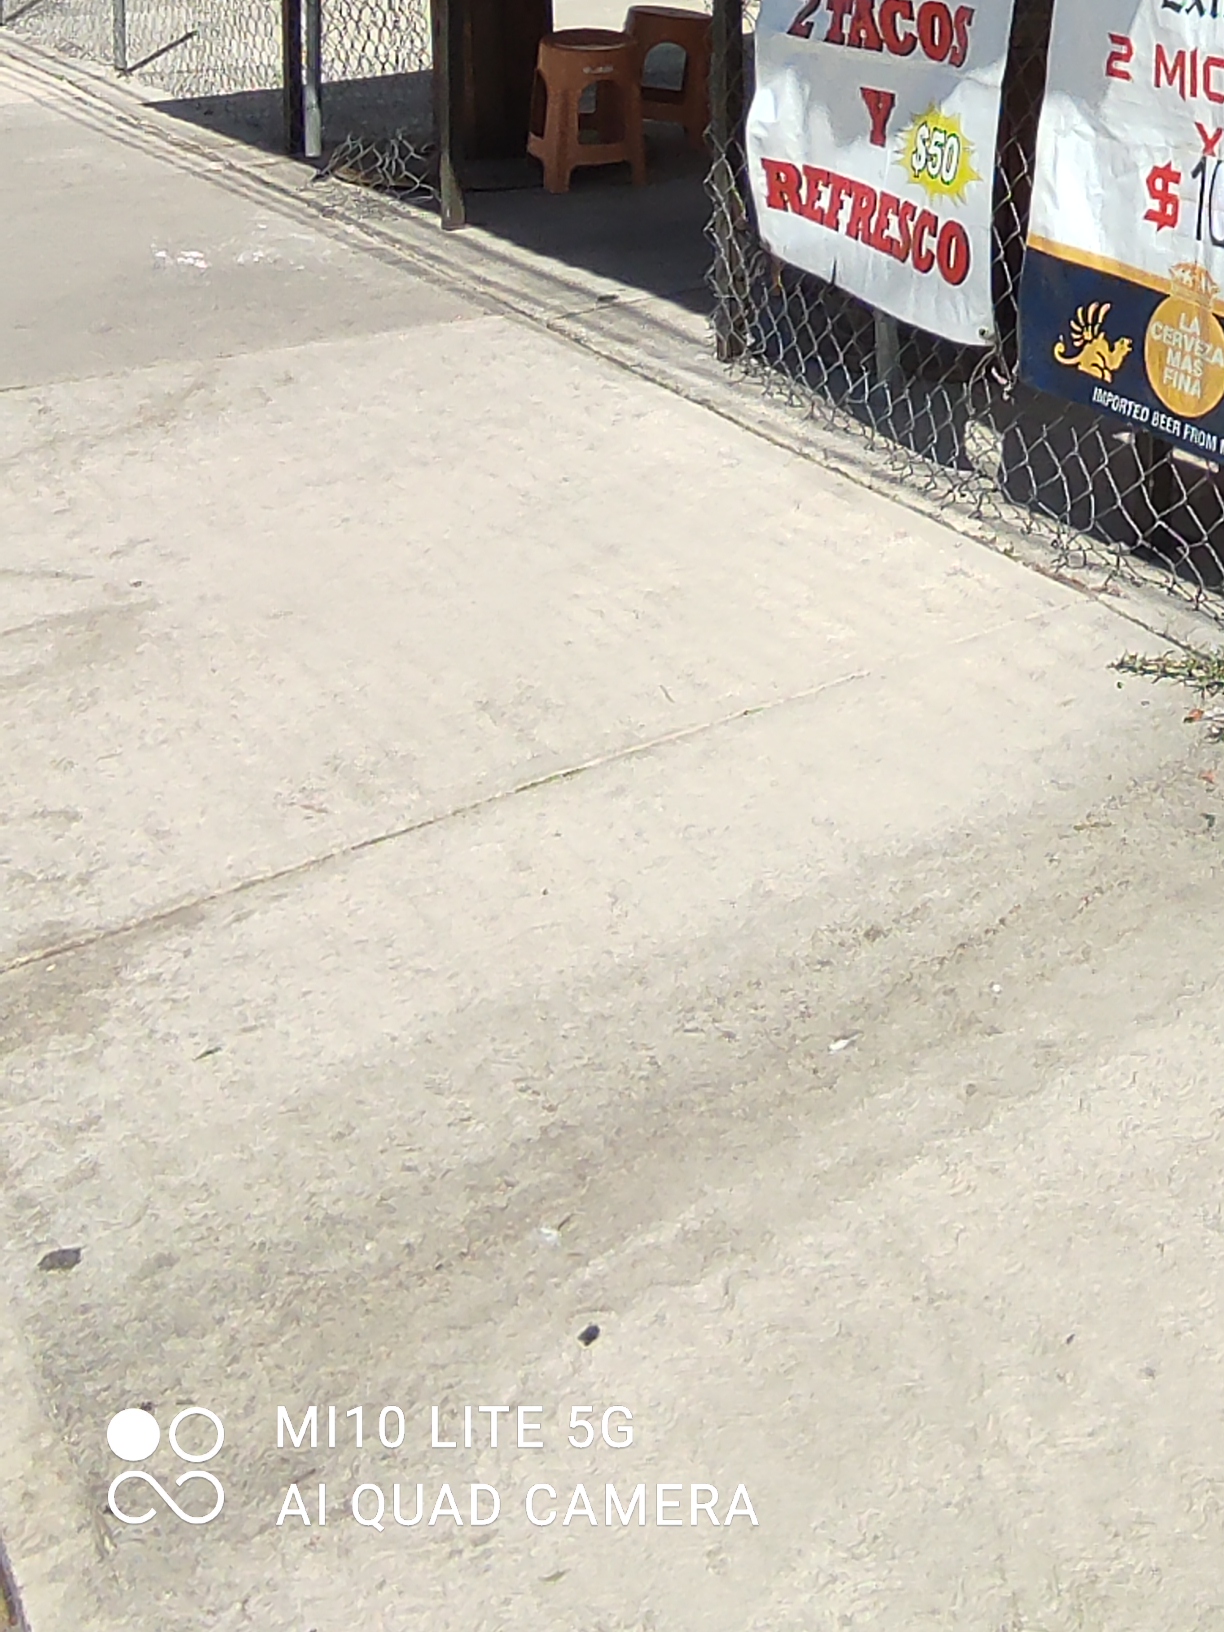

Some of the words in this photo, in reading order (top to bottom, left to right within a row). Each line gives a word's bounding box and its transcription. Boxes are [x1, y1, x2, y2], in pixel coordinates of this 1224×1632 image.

[1105, 32, 1134, 81] 2
[860, 86, 896, 148] Y
[911, 122, 961, 185] $50
[760, 157, 971, 286] REFRESCO
[1179, 312, 1201, 336] LA
[1162, 367, 1202, 399] FINA
[1092, 386, 1151, 424] IMPORTED
[1151, 410, 1181, 436] BEER
[1183, 422, 1219, 454] FROM
